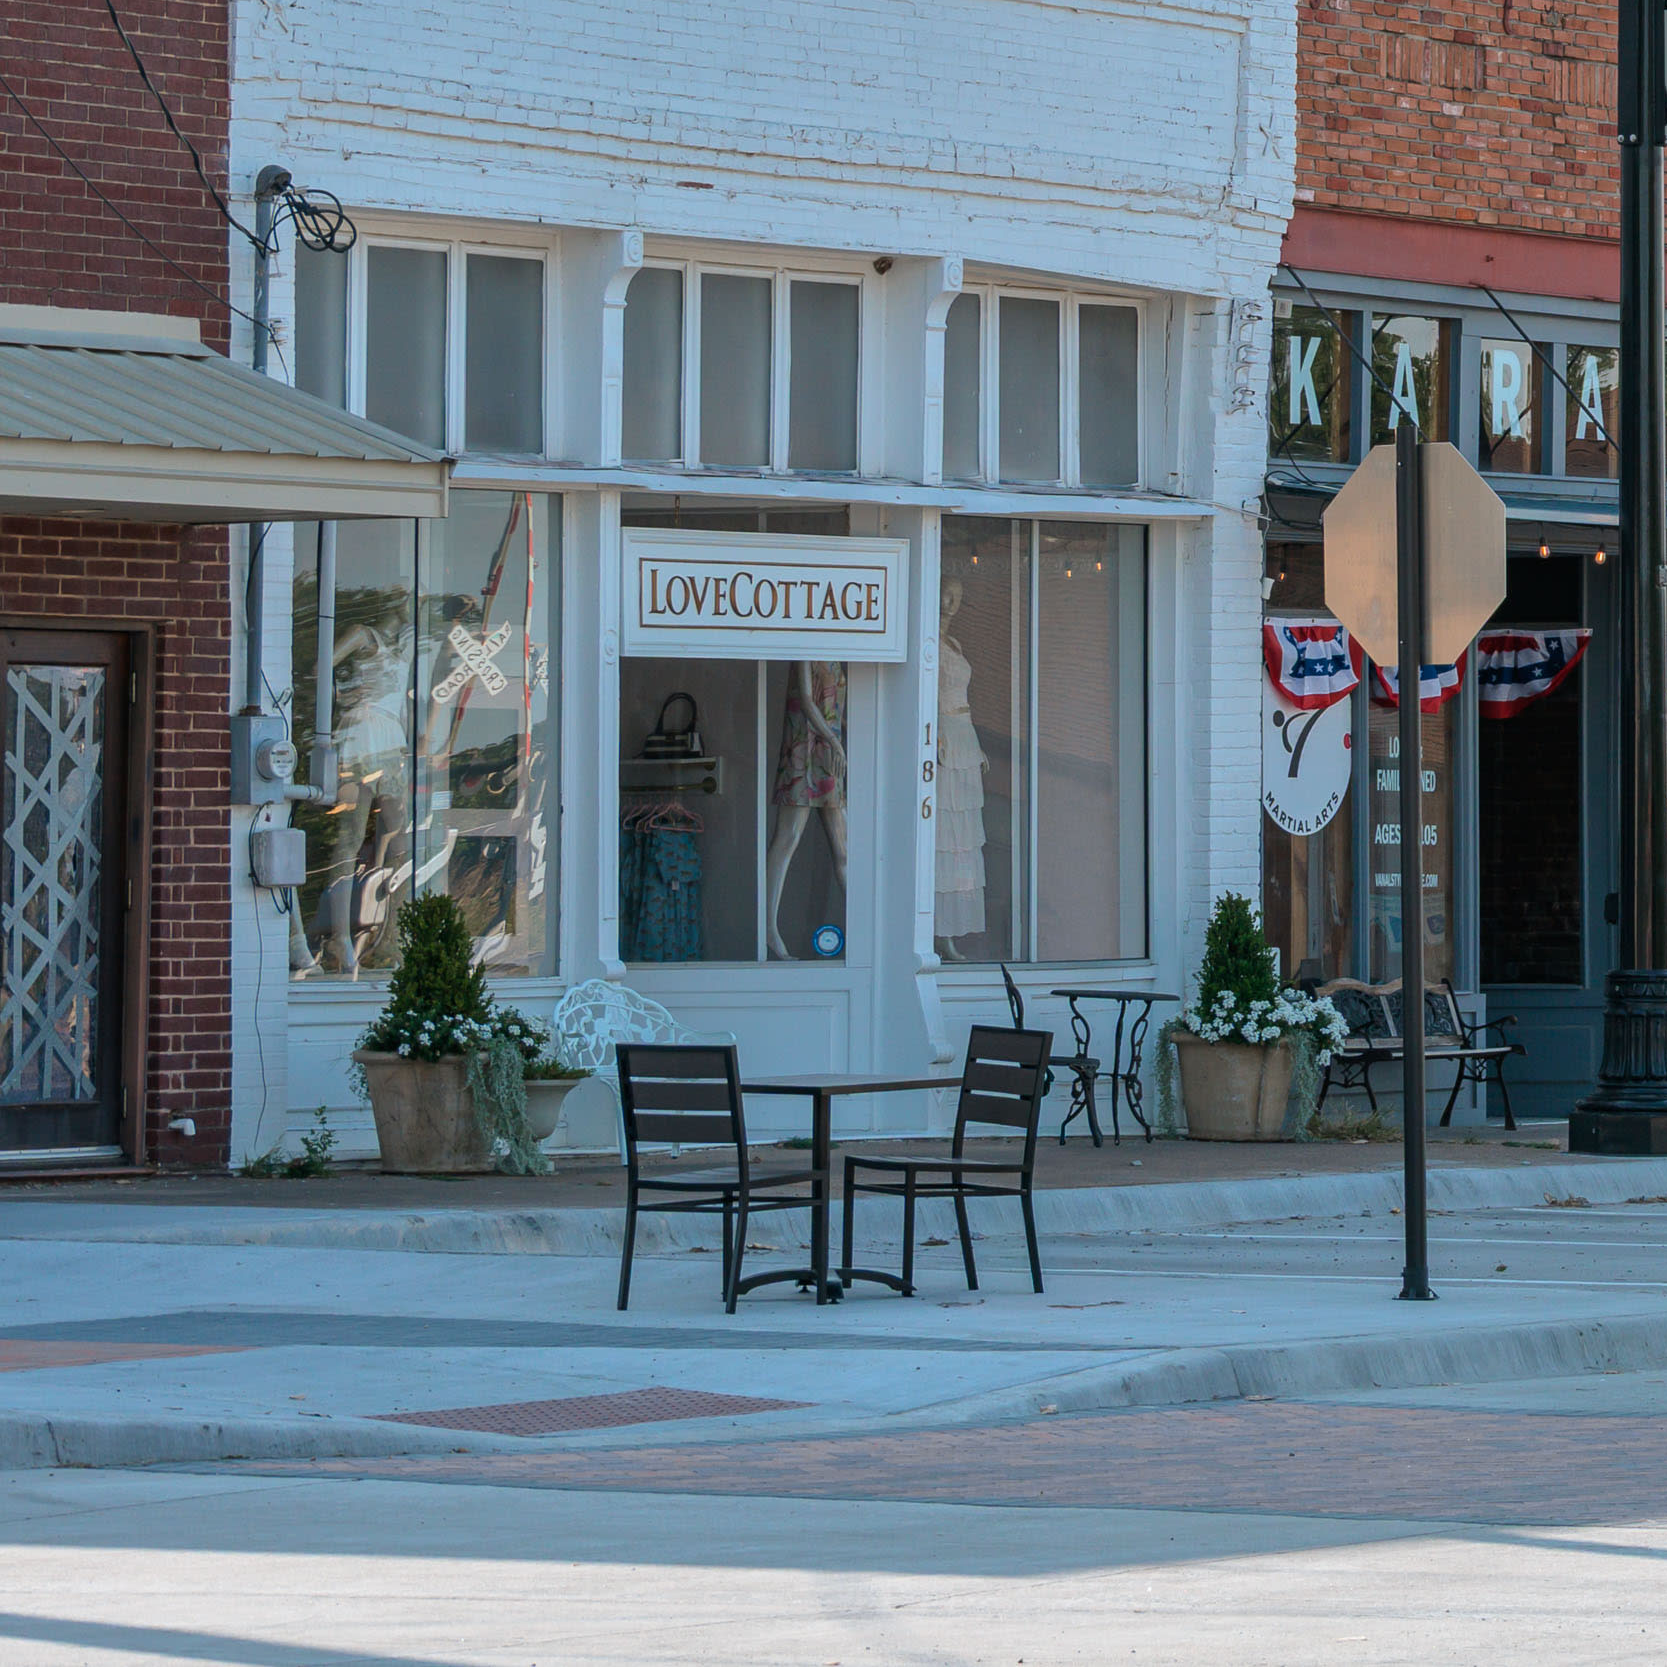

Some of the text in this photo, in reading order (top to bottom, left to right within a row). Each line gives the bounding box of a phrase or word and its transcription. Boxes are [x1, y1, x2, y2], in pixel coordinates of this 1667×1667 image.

[1265, 790, 1340, 834] MARTIAL ARTS
[1374, 823, 1401, 845] AGES
